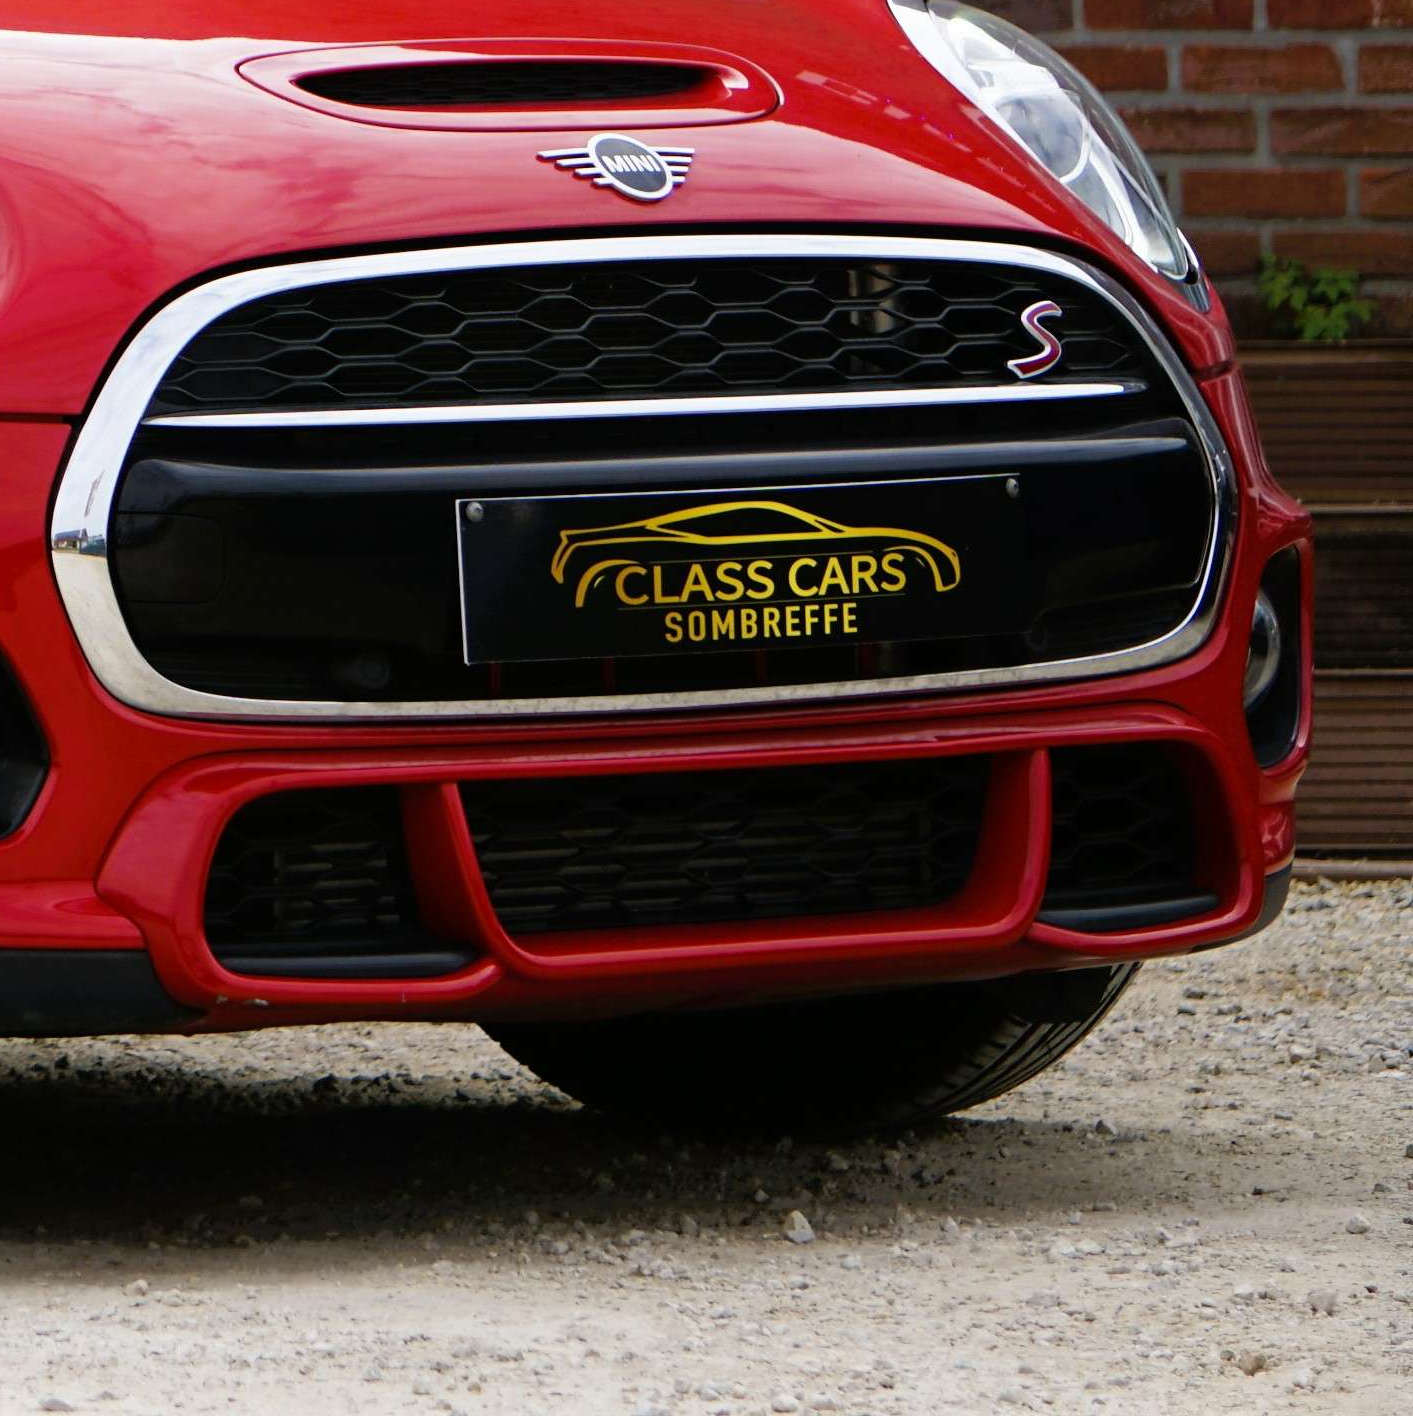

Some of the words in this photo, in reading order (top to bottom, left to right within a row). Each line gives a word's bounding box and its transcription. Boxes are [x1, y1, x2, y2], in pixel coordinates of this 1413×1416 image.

[601, 154, 662, 173] MINI
[1006, 300, 1063, 380] S
[615, 560, 775, 606] CLASS
[787, 551, 907, 599] CARS
[664, 601, 859, 643] SOMBREFFE
